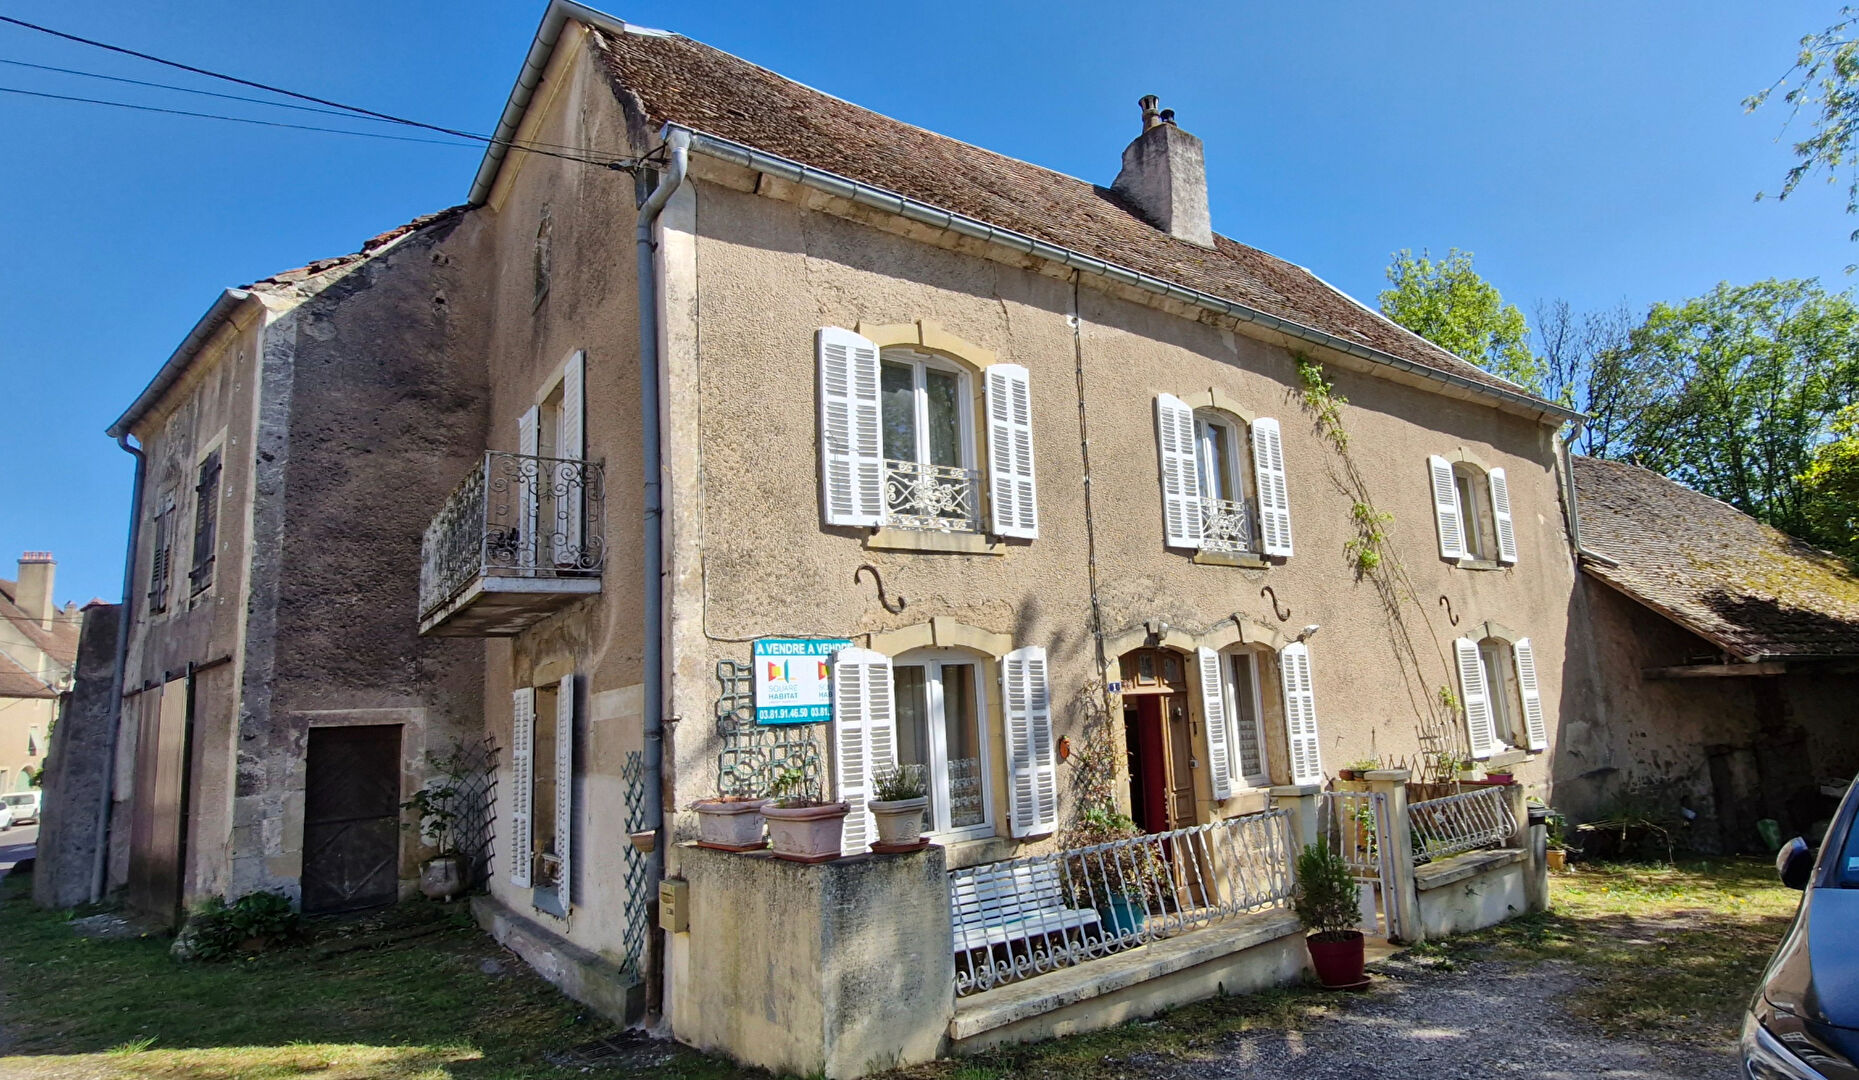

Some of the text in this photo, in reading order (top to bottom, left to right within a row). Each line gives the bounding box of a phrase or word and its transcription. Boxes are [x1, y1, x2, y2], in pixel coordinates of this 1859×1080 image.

[756, 643, 765, 654] A
[766, 643, 805, 654] VENDRE
[807, 643, 815, 654] A
[768, 684, 798, 692] SQUARE
